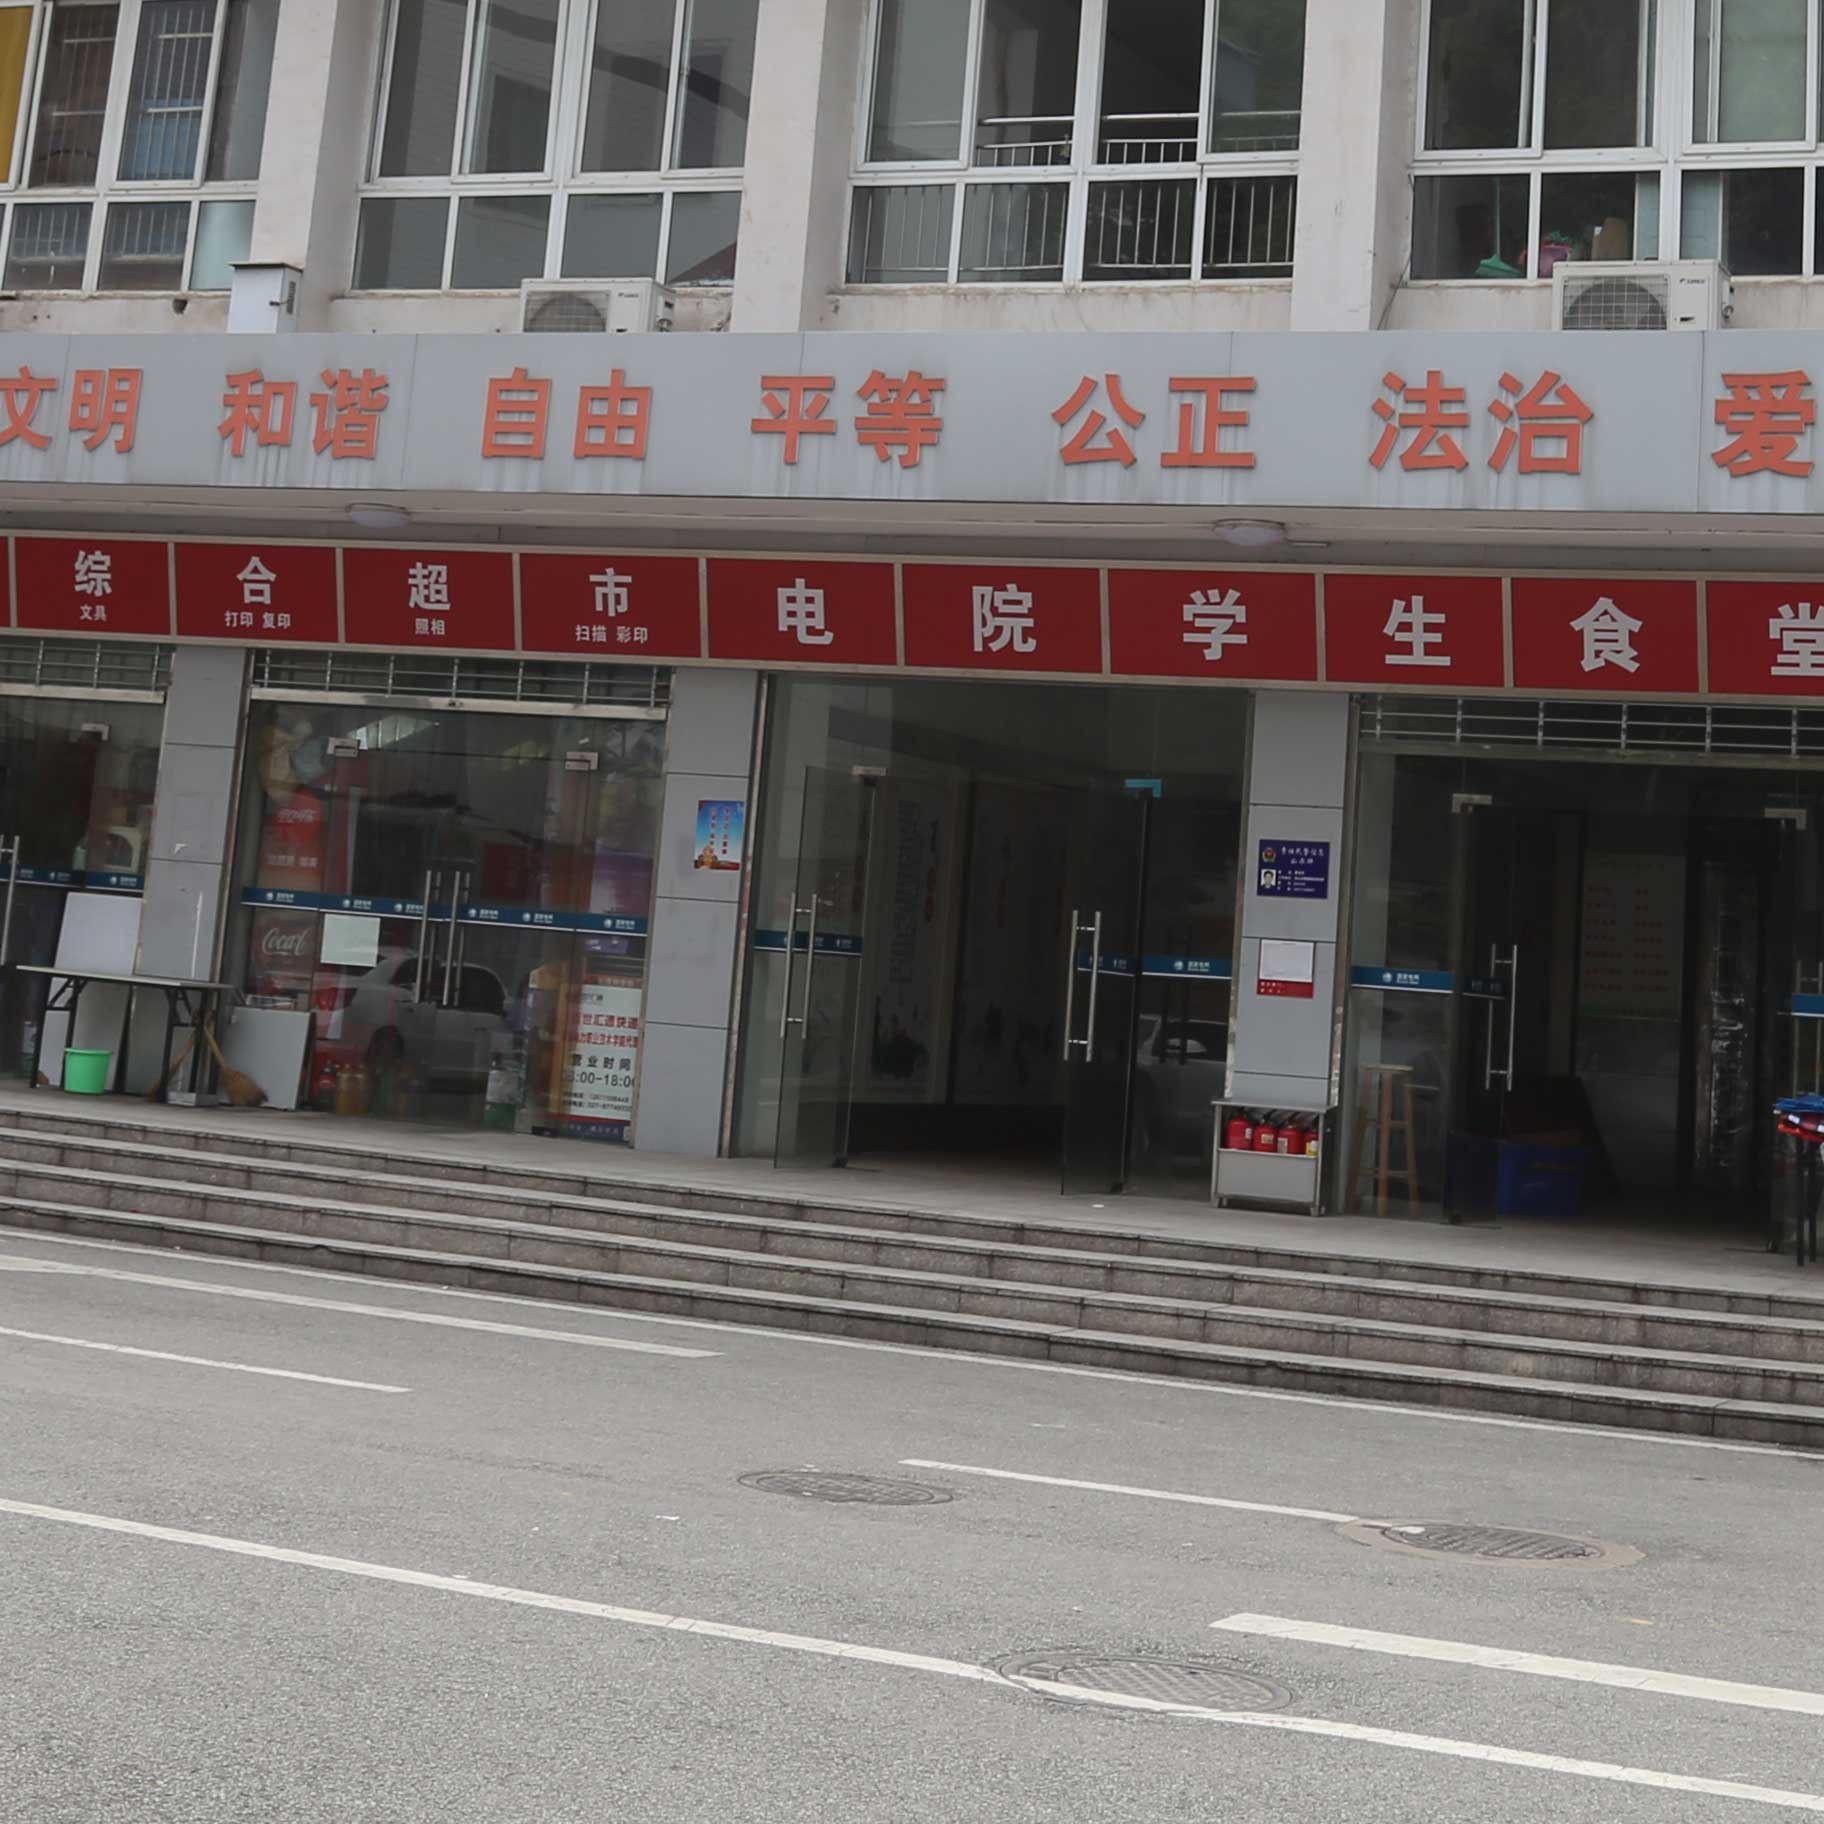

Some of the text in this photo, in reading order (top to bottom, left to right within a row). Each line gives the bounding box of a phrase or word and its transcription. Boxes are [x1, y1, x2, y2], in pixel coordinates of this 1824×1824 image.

[218, 368, 387, 460] 和谐
[480, 366, 652, 461] 自由
[750, 369, 945, 468] 平等
[1052, 374, 1256, 469] 公正
[1369, 370, 1593, 475] 法治
[80, 605, 107, 621] 文具
[224, 611, 291, 630] 打印 复印
[415, 618, 445, 635] 照相
[575, 625, 648, 644] 扫描 彩印
